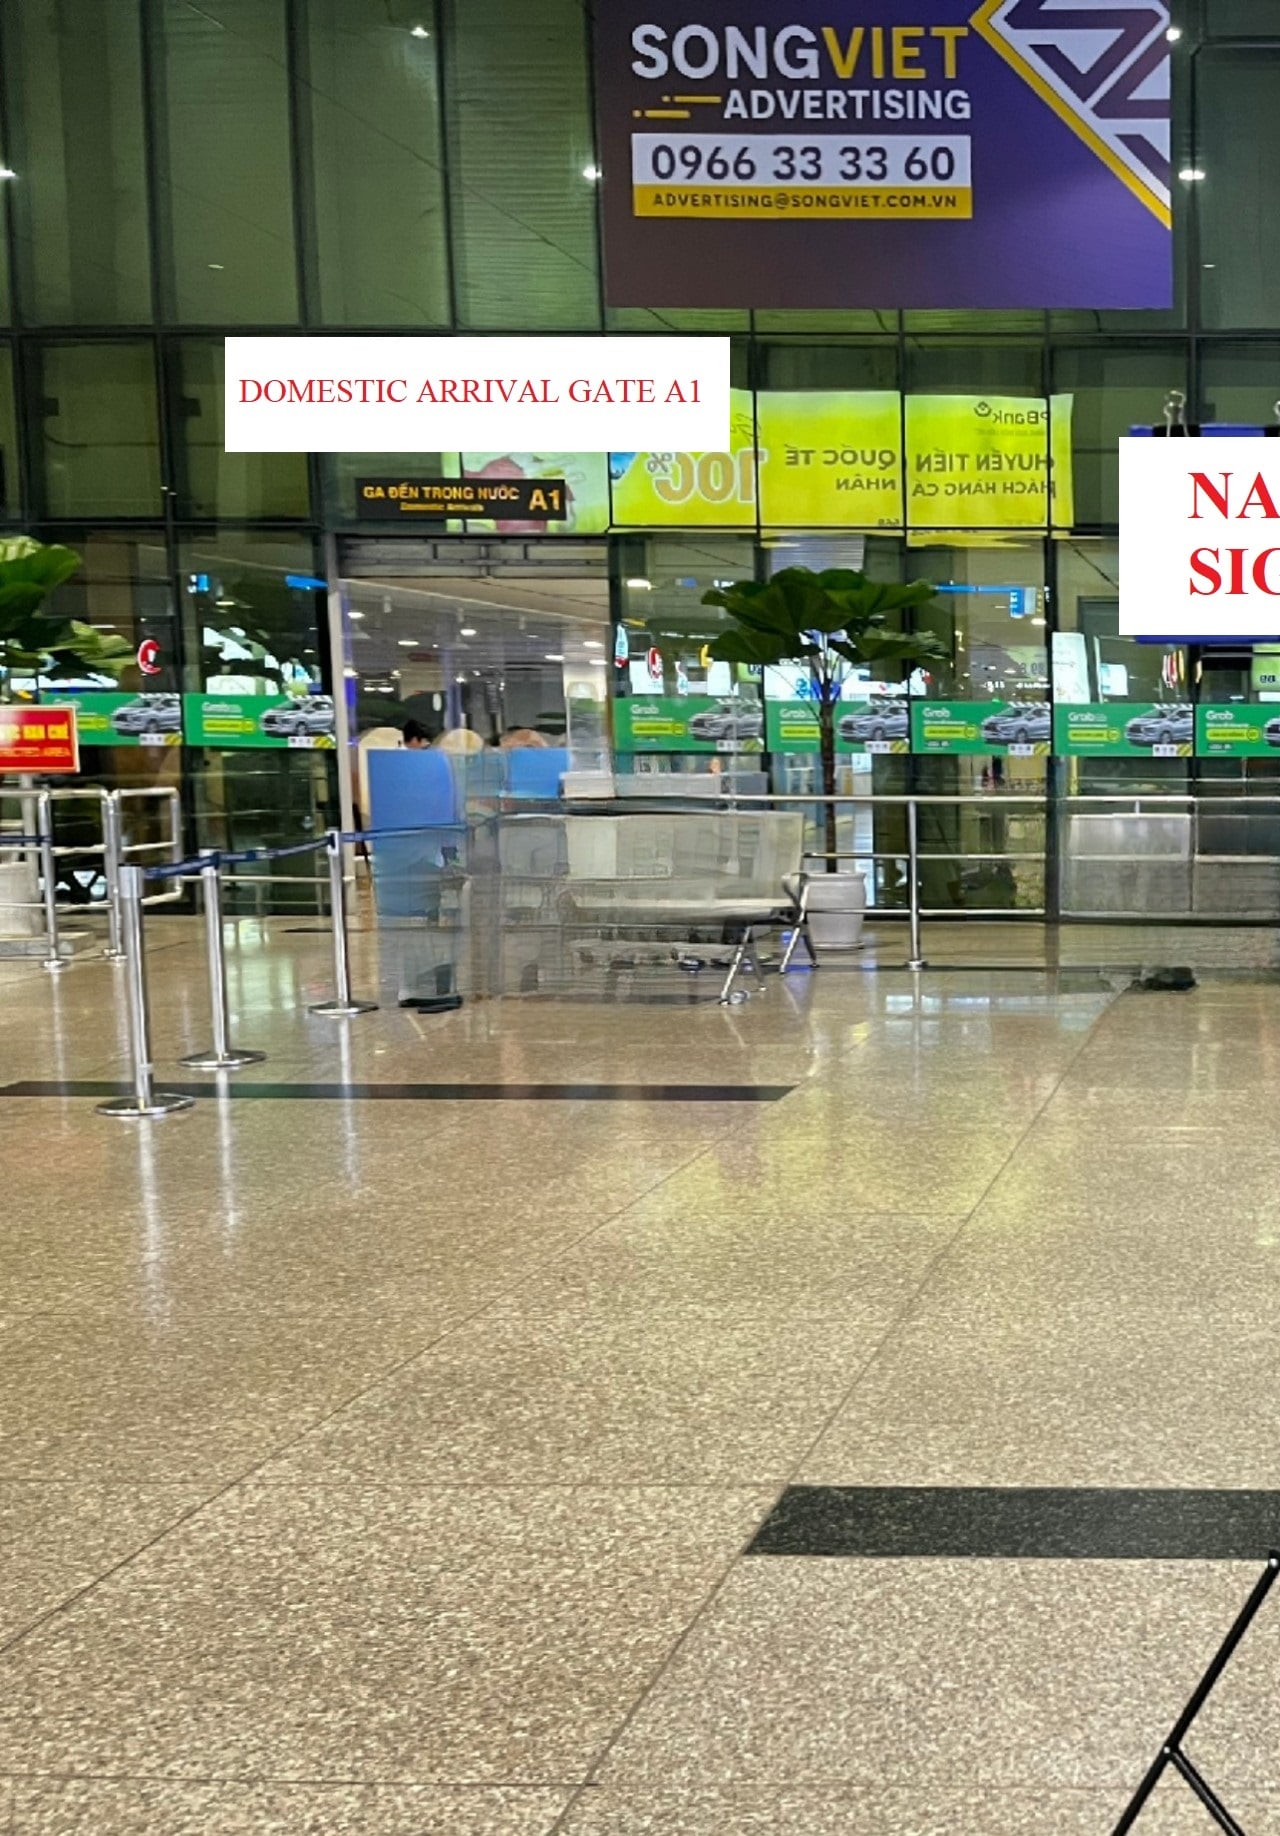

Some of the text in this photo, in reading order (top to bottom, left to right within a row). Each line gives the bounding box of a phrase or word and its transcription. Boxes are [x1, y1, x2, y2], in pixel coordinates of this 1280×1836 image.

[631, 24, 968, 79] SONGVIET
[723, 89, 971, 119] ADVERTISING
[651, 145, 955, 181] 0966 33 33 60
[653, 193, 957, 210] ADVERTISING@SONGVIET.COM.VN
[363, 486, 385, 499] GA
[421, 486, 475, 500] TRONG
[529, 488, 561, 511] A1
[922, 706, 950, 718] Grab
[1068, 711, 1095, 722] Grab
[1206, 710, 1233, 721] Grab
